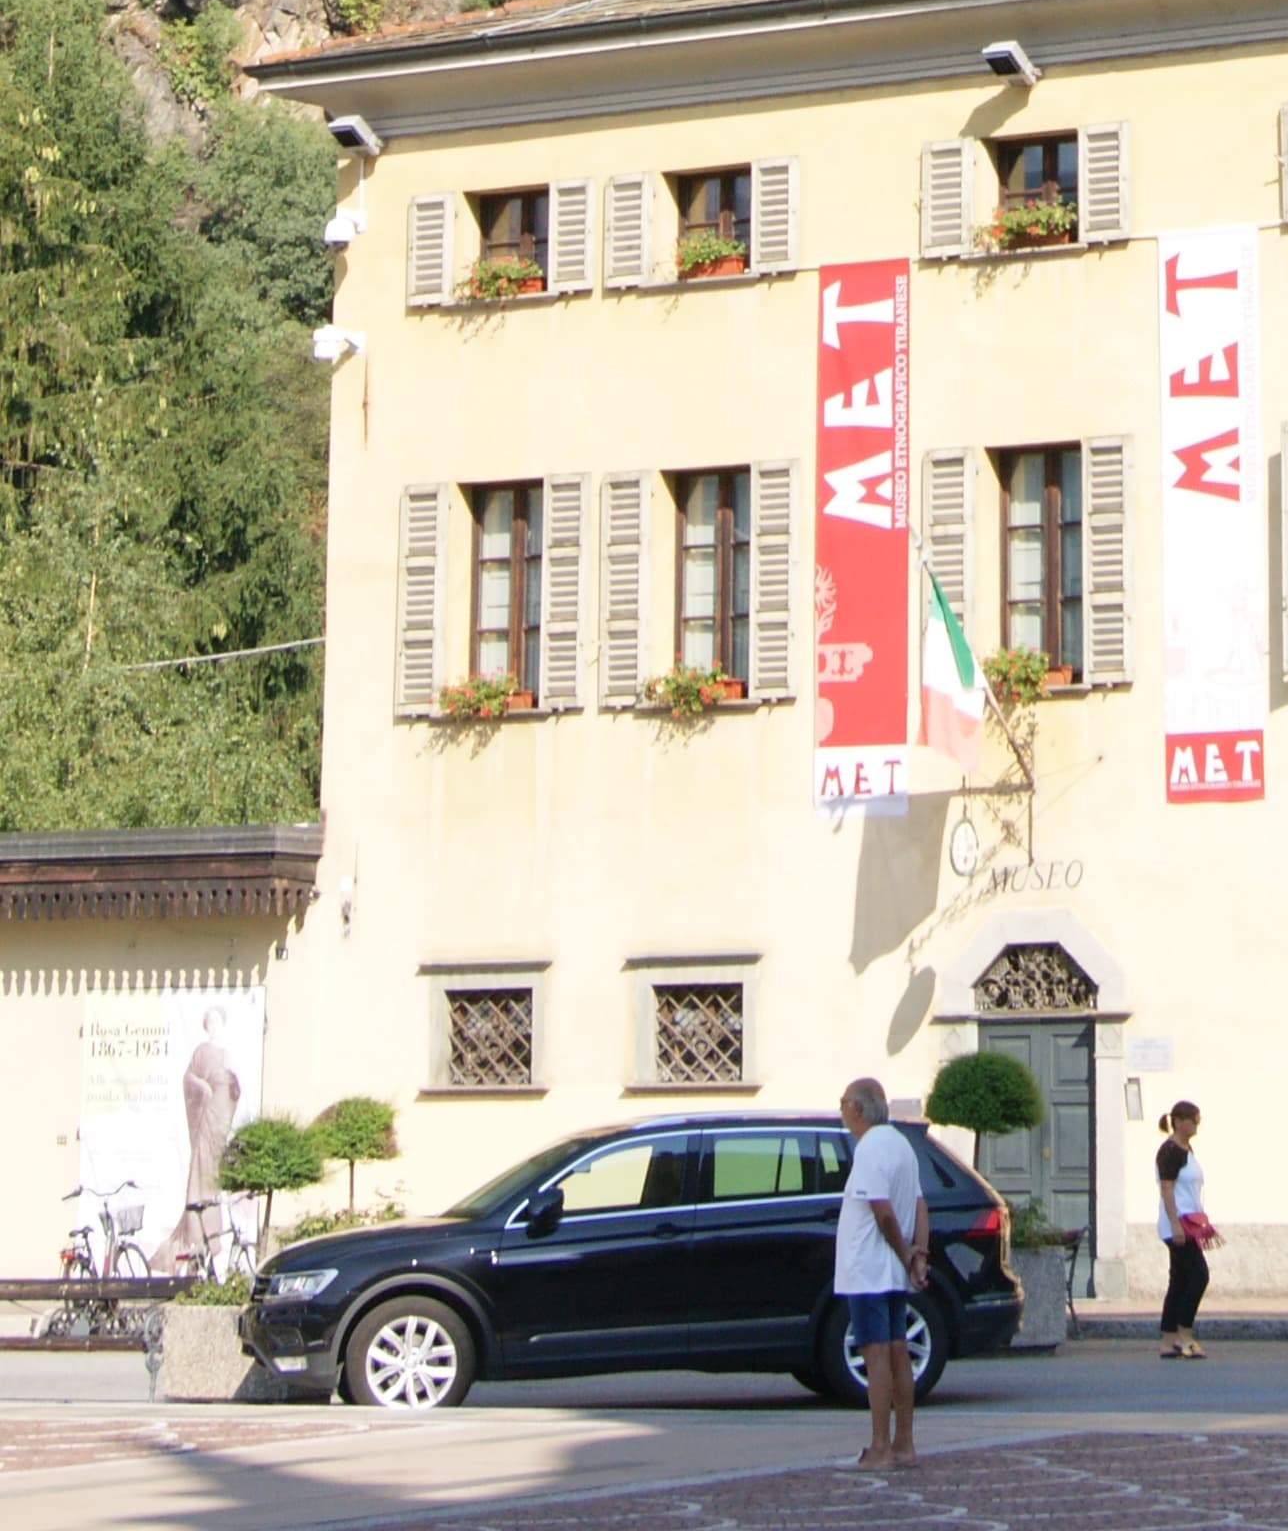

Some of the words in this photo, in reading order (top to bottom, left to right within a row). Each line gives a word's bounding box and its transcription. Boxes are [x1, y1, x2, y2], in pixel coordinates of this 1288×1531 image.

[895, 275, 908, 350] TIRANESE
[822, 280, 895, 530] MET
[1165, 252, 1241, 502] MET
[895, 354, 908, 467] ETNOGRAFICO
[895, 472, 908, 529] MUSEO
[820, 759, 902, 796] MET
[1170, 740, 1260, 783] MET
[990, 859, 1084, 893] MUSEO
[90, 1022, 121, 1036] Rosa
